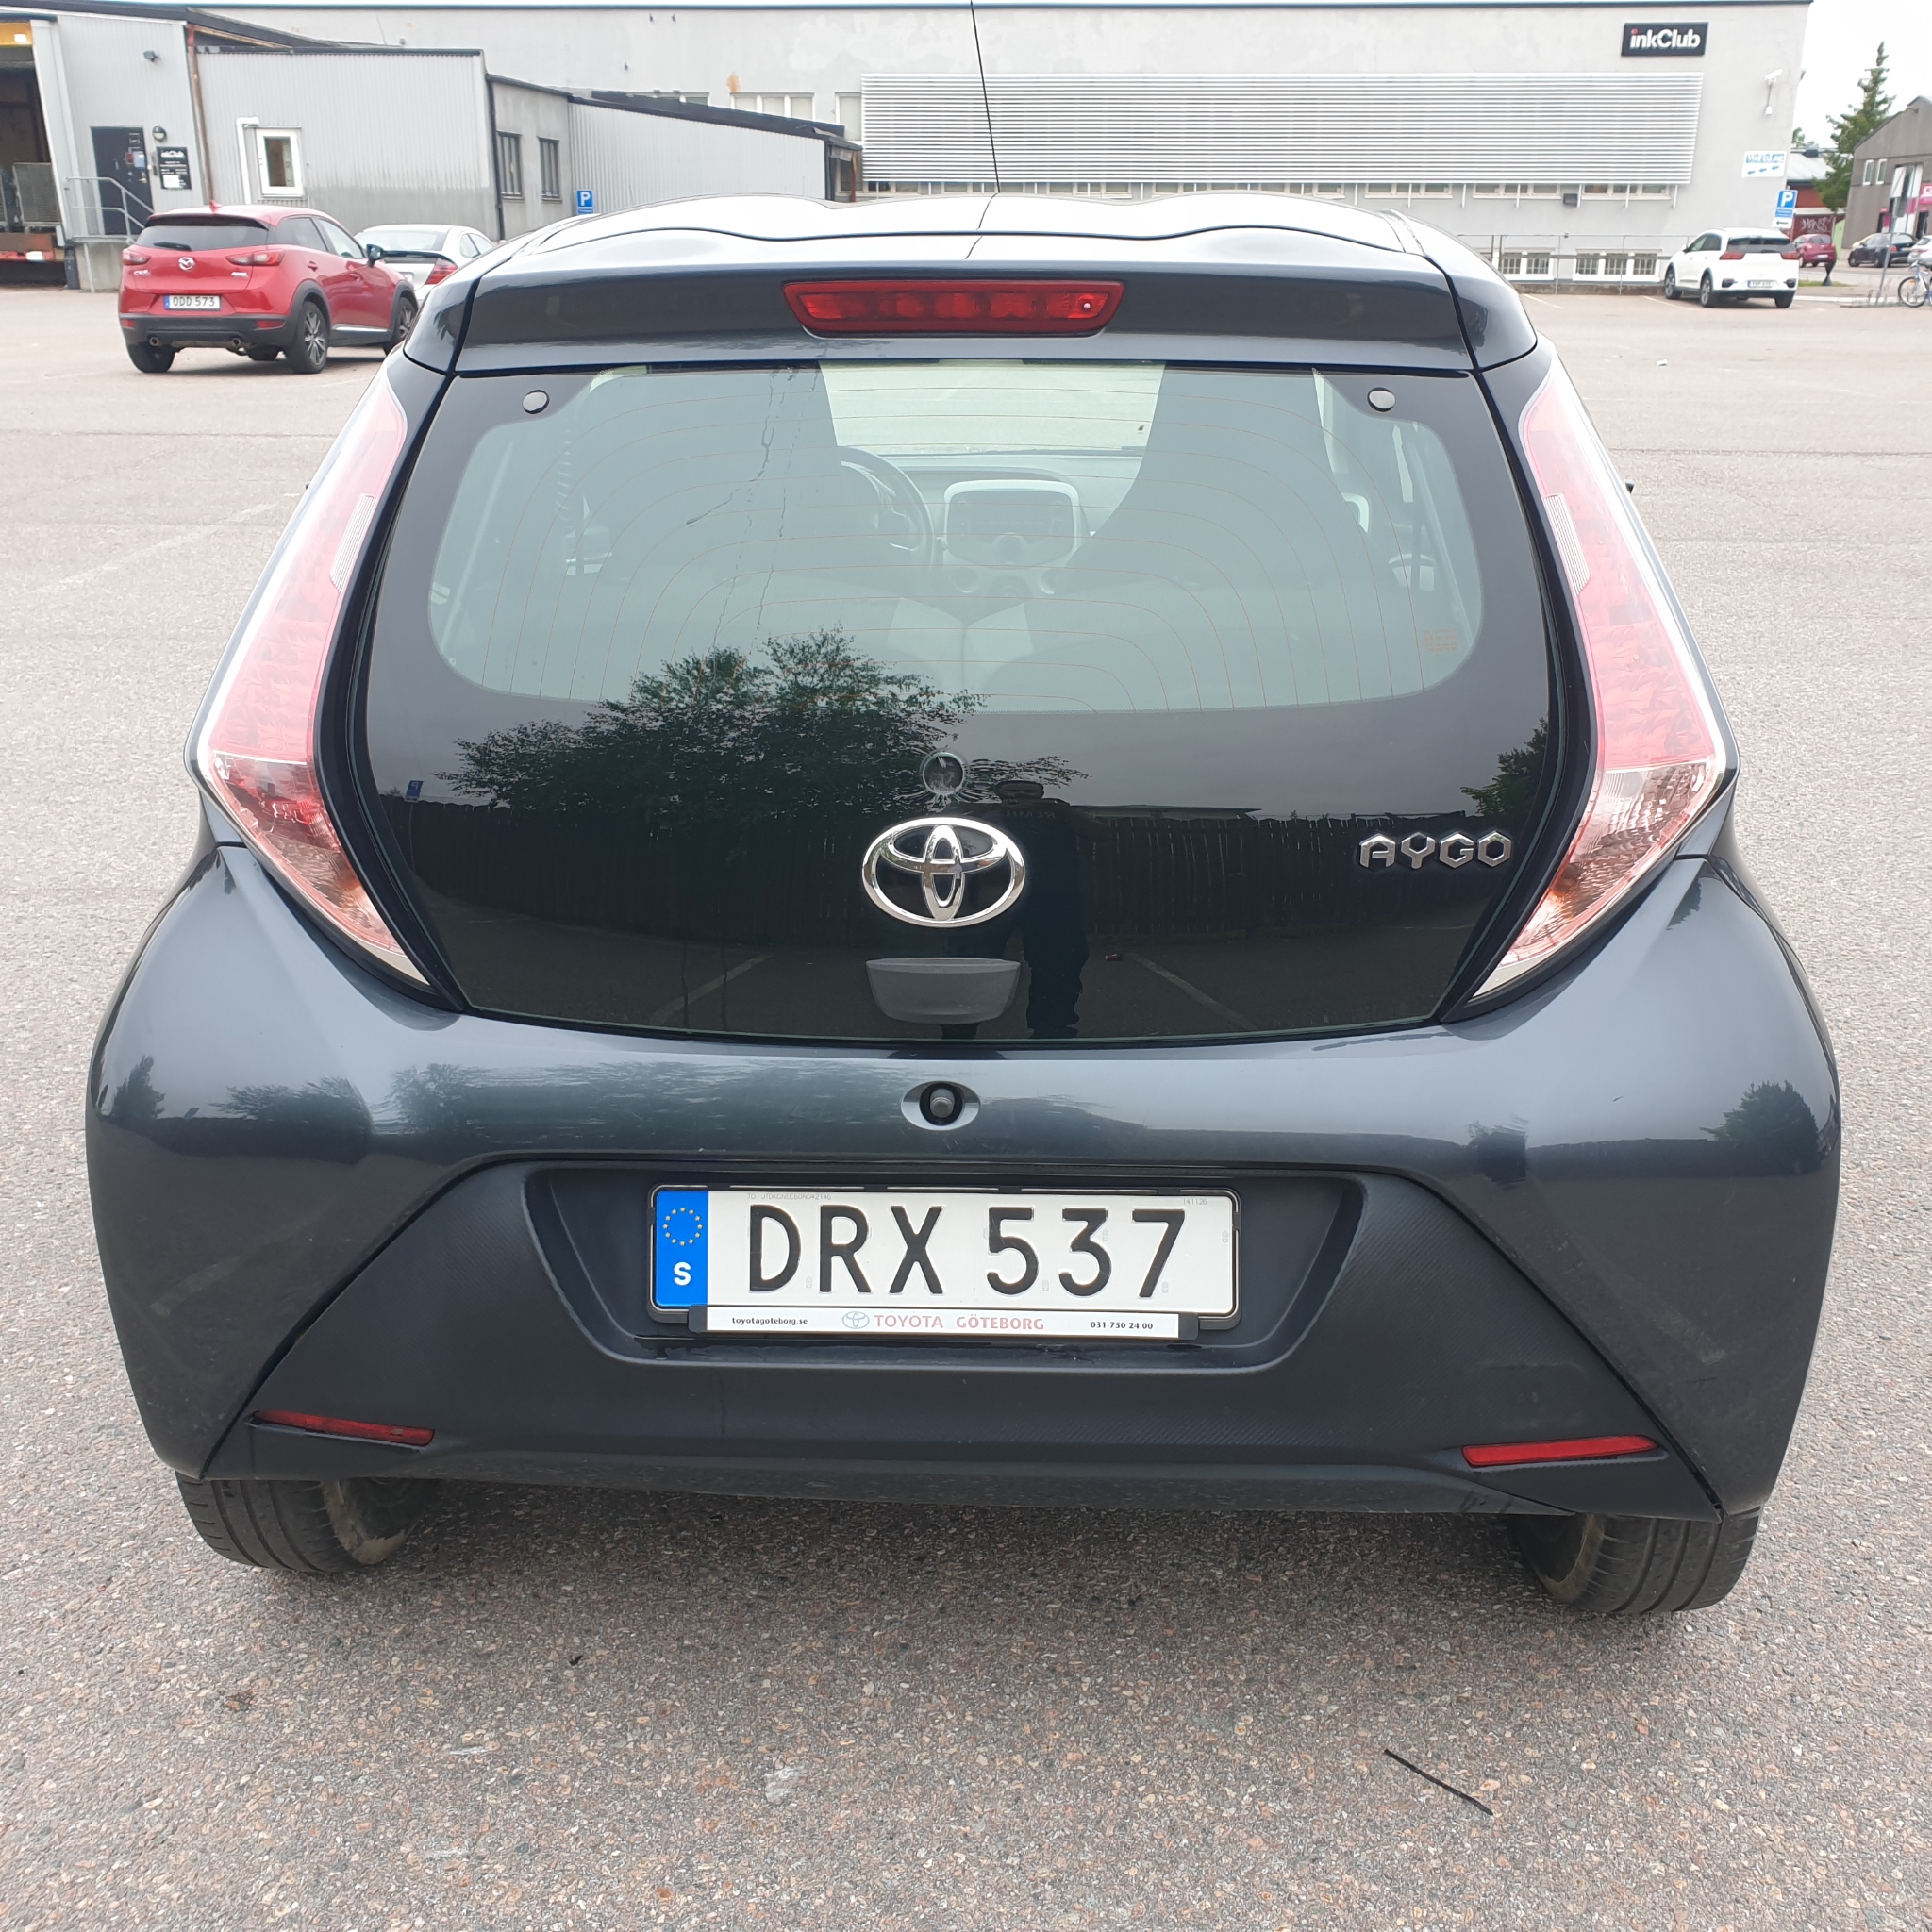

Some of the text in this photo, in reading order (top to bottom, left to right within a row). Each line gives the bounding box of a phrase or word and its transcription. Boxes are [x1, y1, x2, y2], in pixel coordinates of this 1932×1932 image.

[1630, 28, 1701, 48] inkClub
[579, 191, 591, 207] P
[1780, 192, 1794, 208] P
[194, 296, 215, 307] 573
[1359, 832, 1512, 870] AYGO
[749, 1204, 1186, 1299] DRX 537
[674, 1261, 691, 1286] S
[732, 1316, 808, 1325] toyotagoteborg.se
[874, 1313, 1044, 1330] TOYOTA GÖTEBORG
[1091, 1321, 1154, 1330] 031-750 24 00
